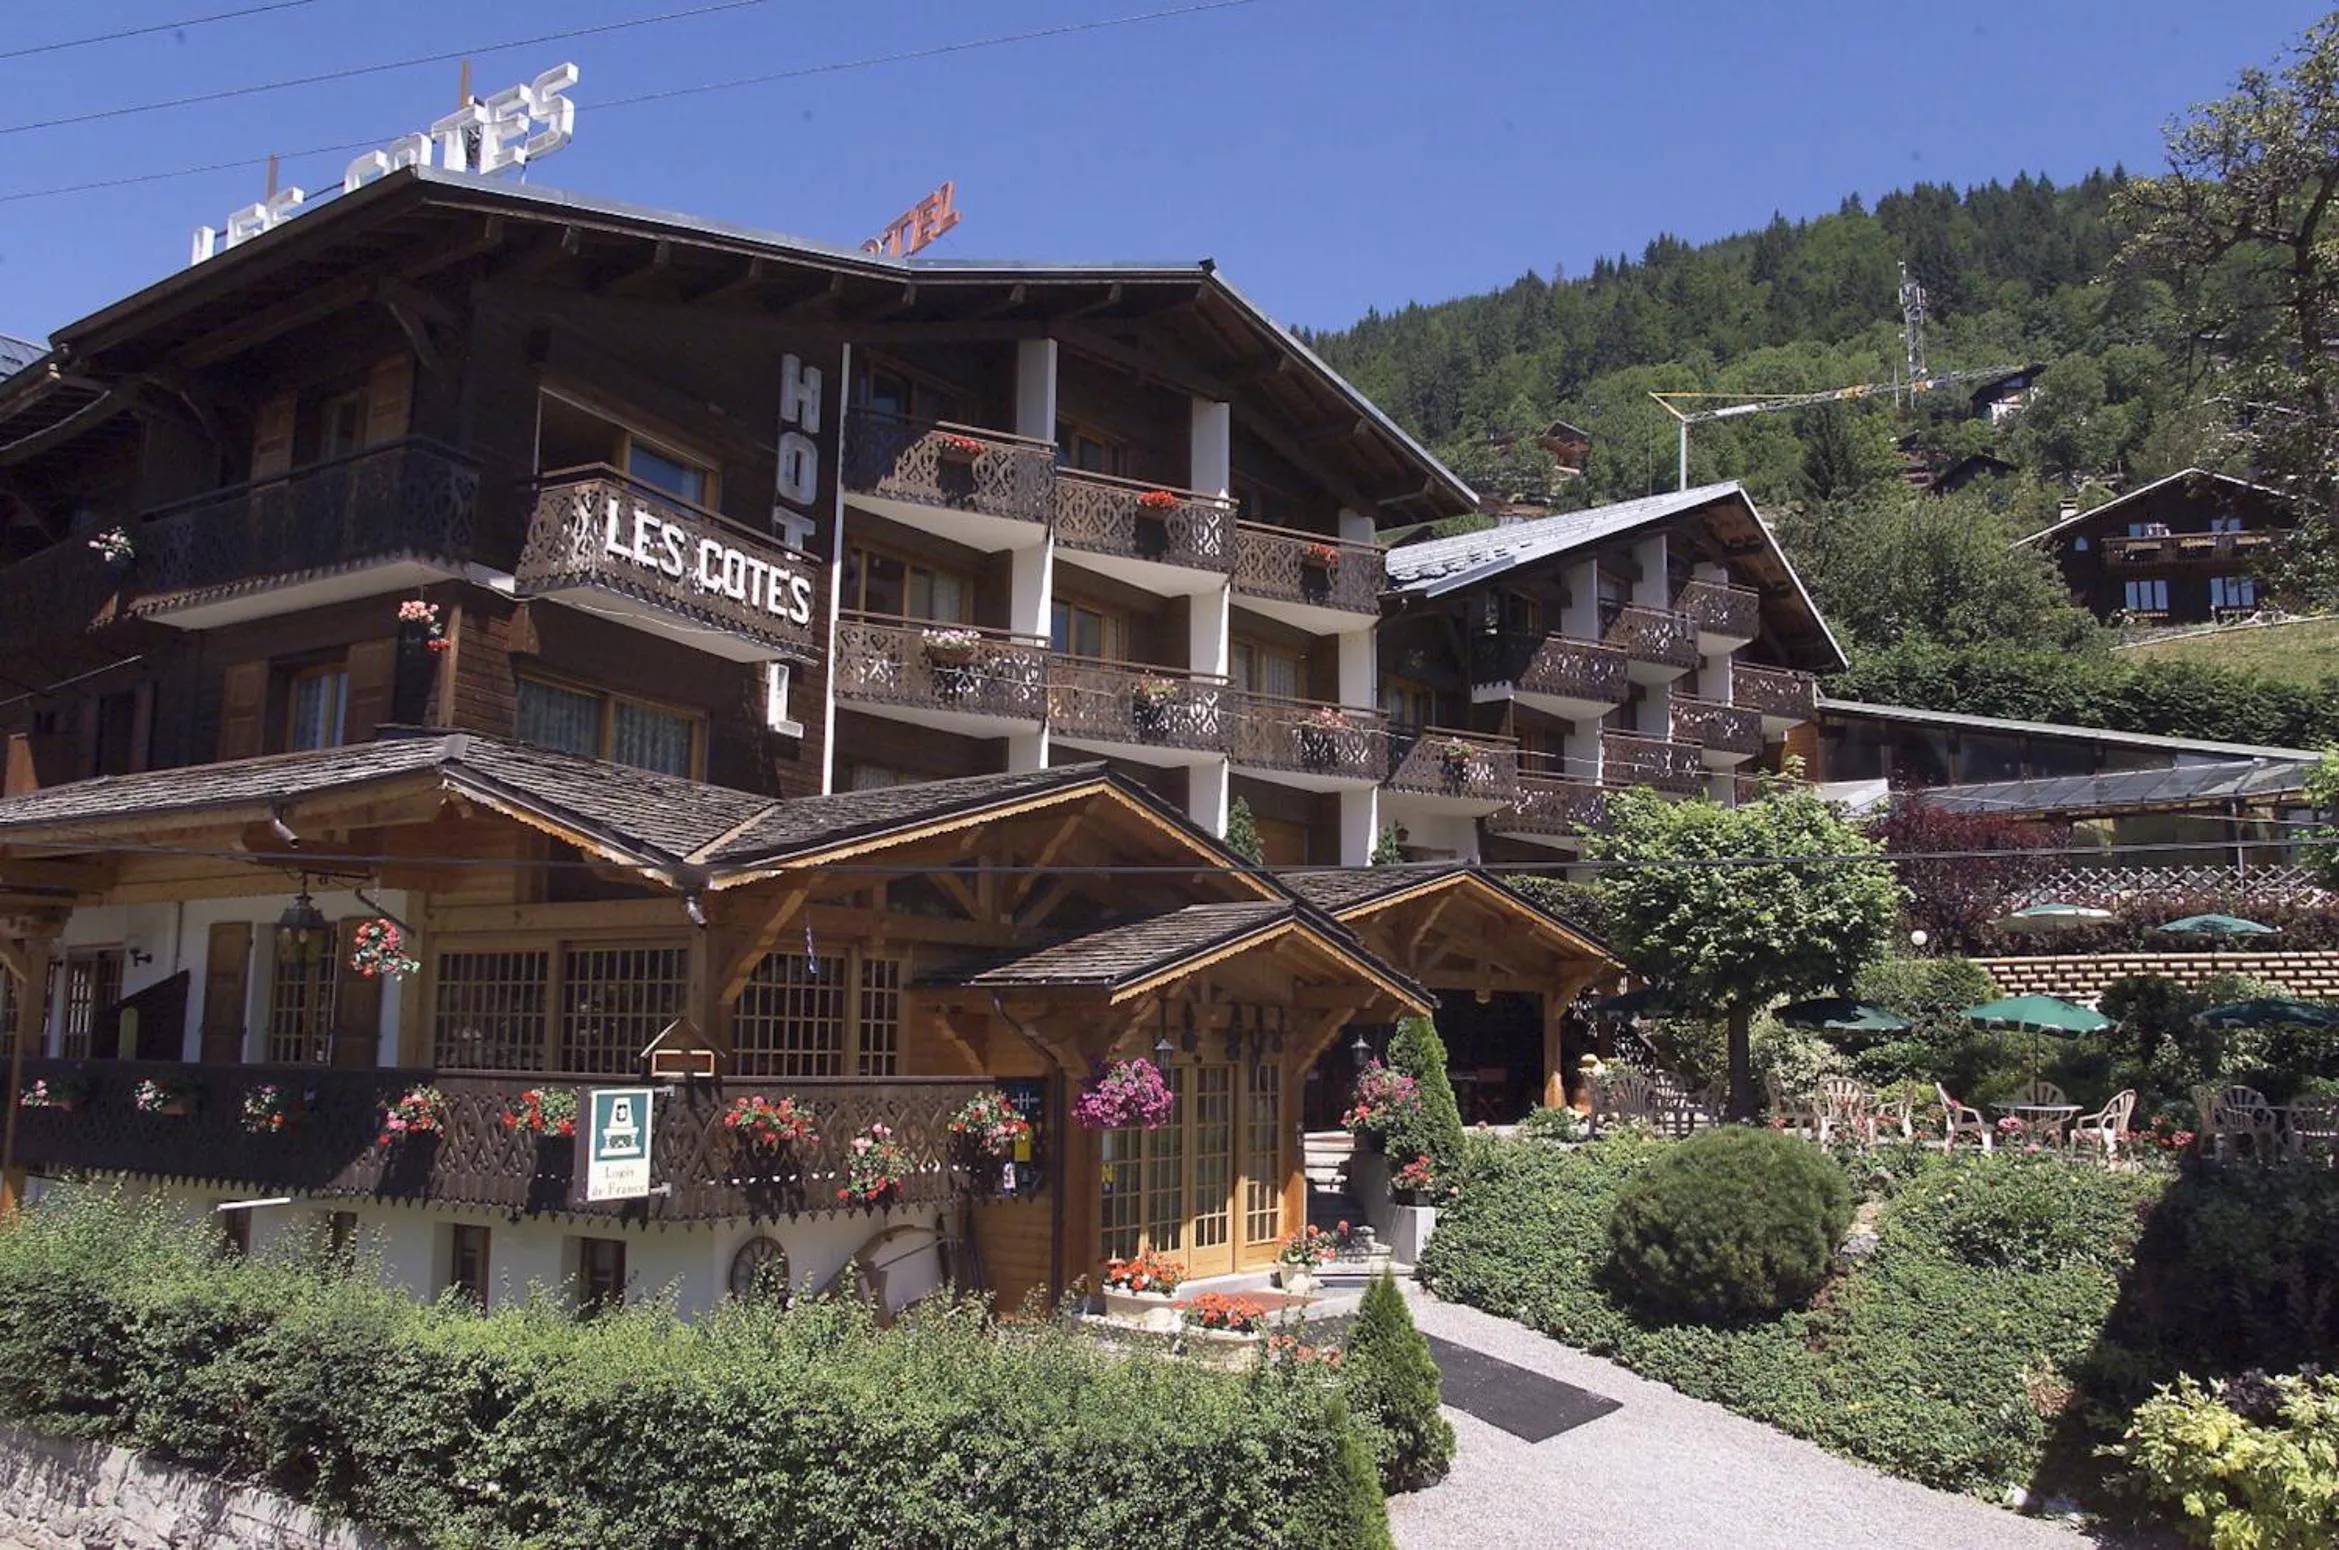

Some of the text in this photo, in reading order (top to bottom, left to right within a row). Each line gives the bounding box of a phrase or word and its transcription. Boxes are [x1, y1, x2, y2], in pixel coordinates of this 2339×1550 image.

[605, 499, 811, 625] LES COTES
[767, 353, 822, 739] HOTL
[608, 1182, 645, 1195] France
